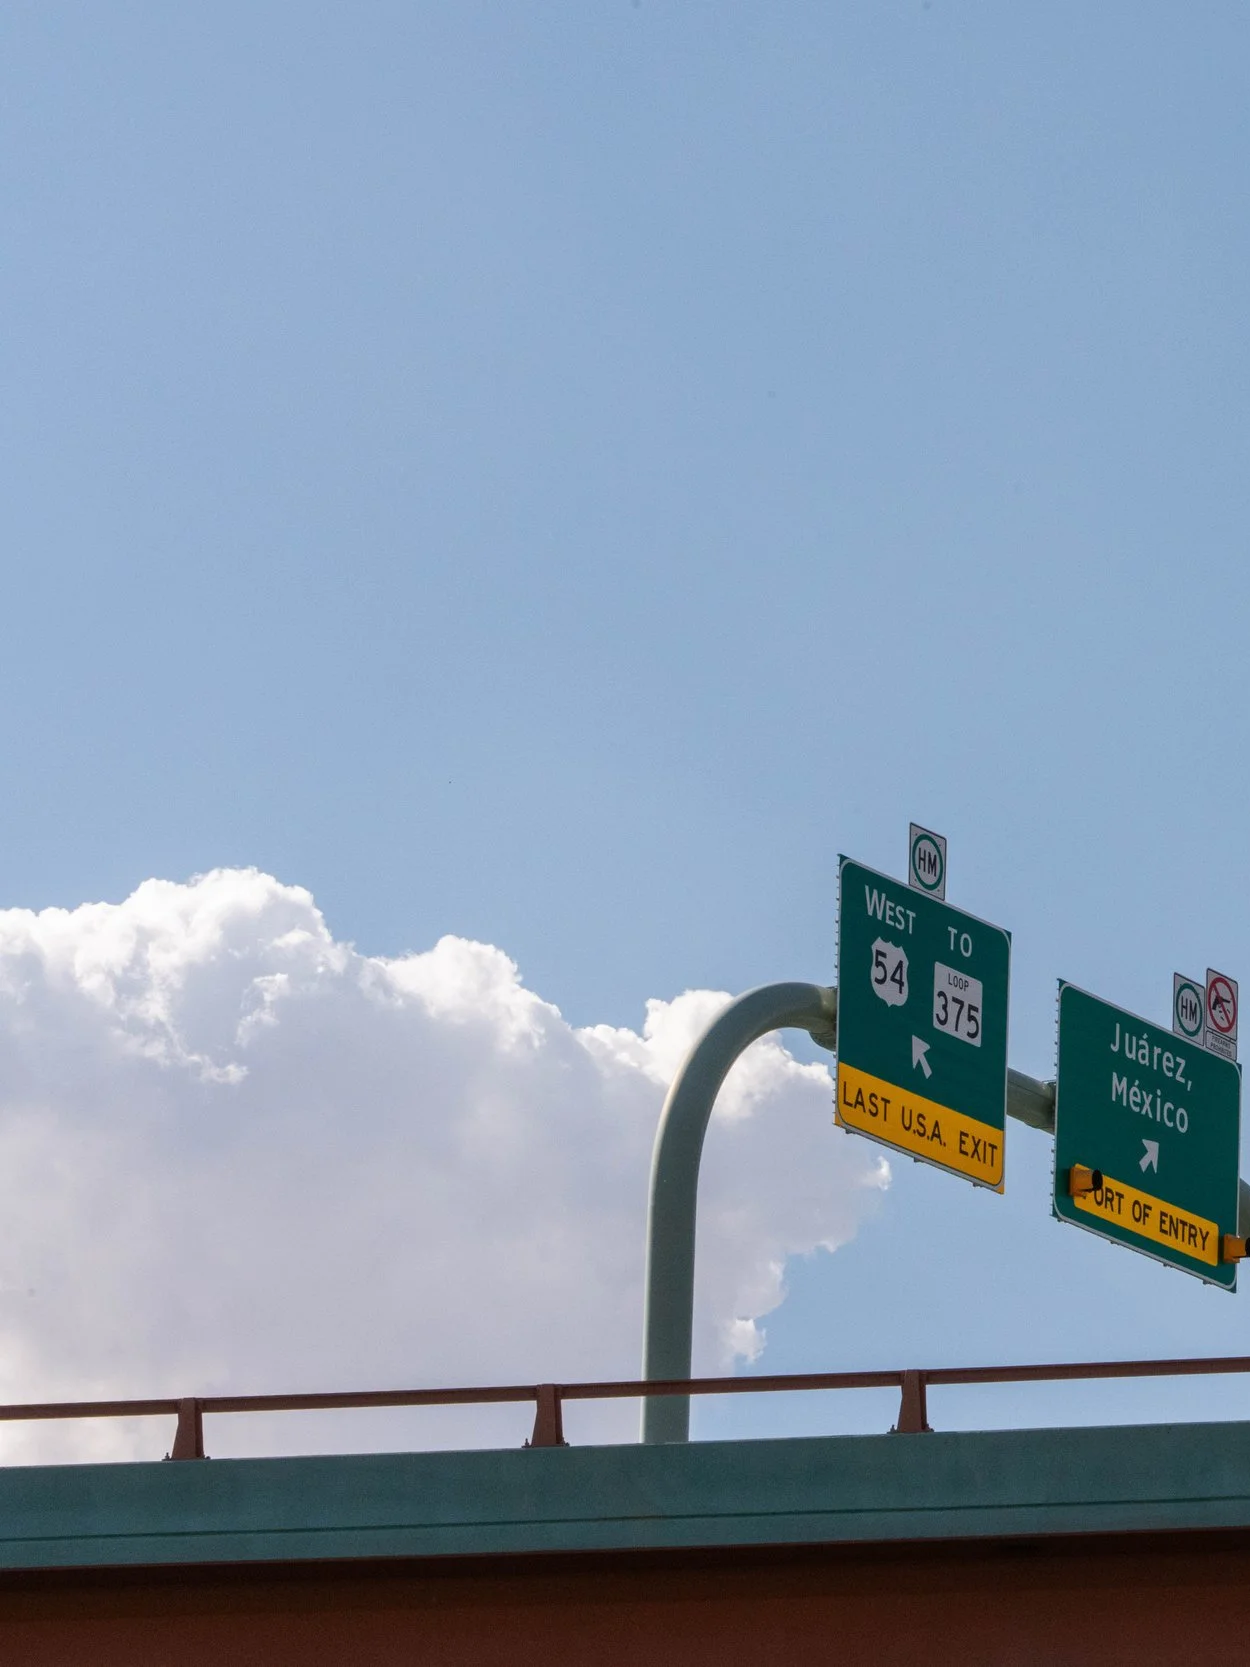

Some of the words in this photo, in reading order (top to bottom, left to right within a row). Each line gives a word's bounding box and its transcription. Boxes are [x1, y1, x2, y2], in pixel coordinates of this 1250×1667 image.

[918, 848, 937, 877] HM
[865, 885, 916, 935] WEST
[948, 926, 972, 957] TO
[874, 949, 905, 994] 54
[948, 973, 969, 992] LOOP
[936, 991, 980, 1039] 375
[1181, 995, 1197, 1024] HM
[1110, 1023, 1192, 1091] Juárez,
[843, 1081, 890, 1121] LAST
[902, 1106, 946, 1147] U.S.A.
[959, 1131, 998, 1167] EXIT
[1112, 1072, 1188, 1133] México
[1083, 1186, 1124, 1215] ORT
[1132, 1200, 1152, 1225] OF
[1159, 1211, 1209, 1251] ENTRY
